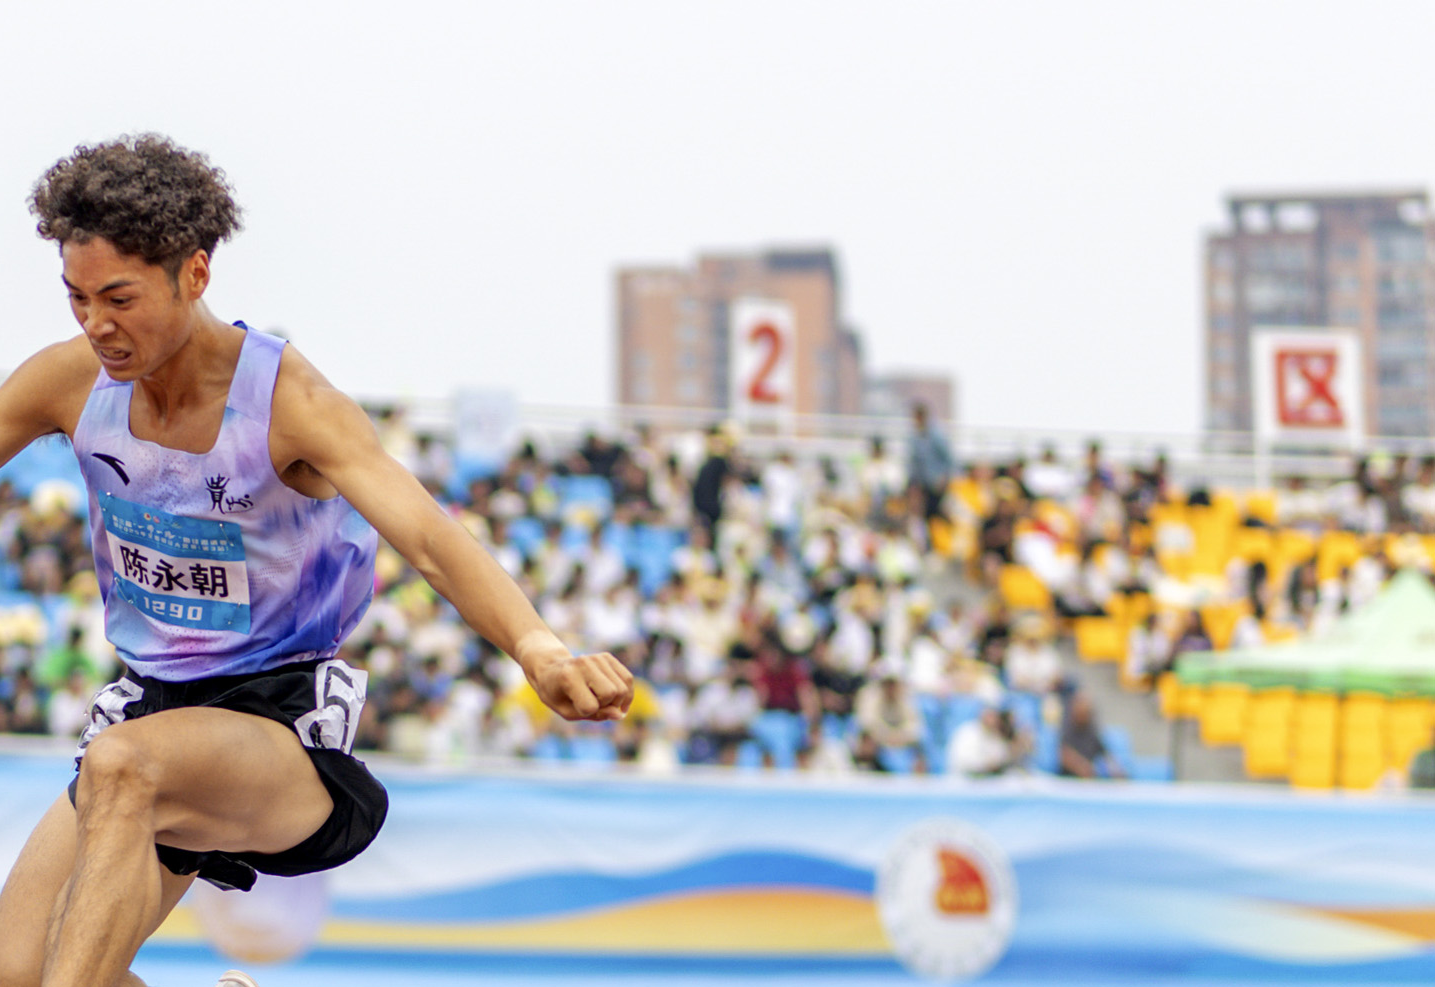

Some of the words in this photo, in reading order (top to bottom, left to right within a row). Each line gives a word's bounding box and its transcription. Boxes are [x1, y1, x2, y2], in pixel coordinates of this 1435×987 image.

[747, 321, 781, 405] 2
[1275, 348, 1345, 428] 区
[119, 545, 229, 598] 陈永朝
[143, 596, 203, 621] 1290
